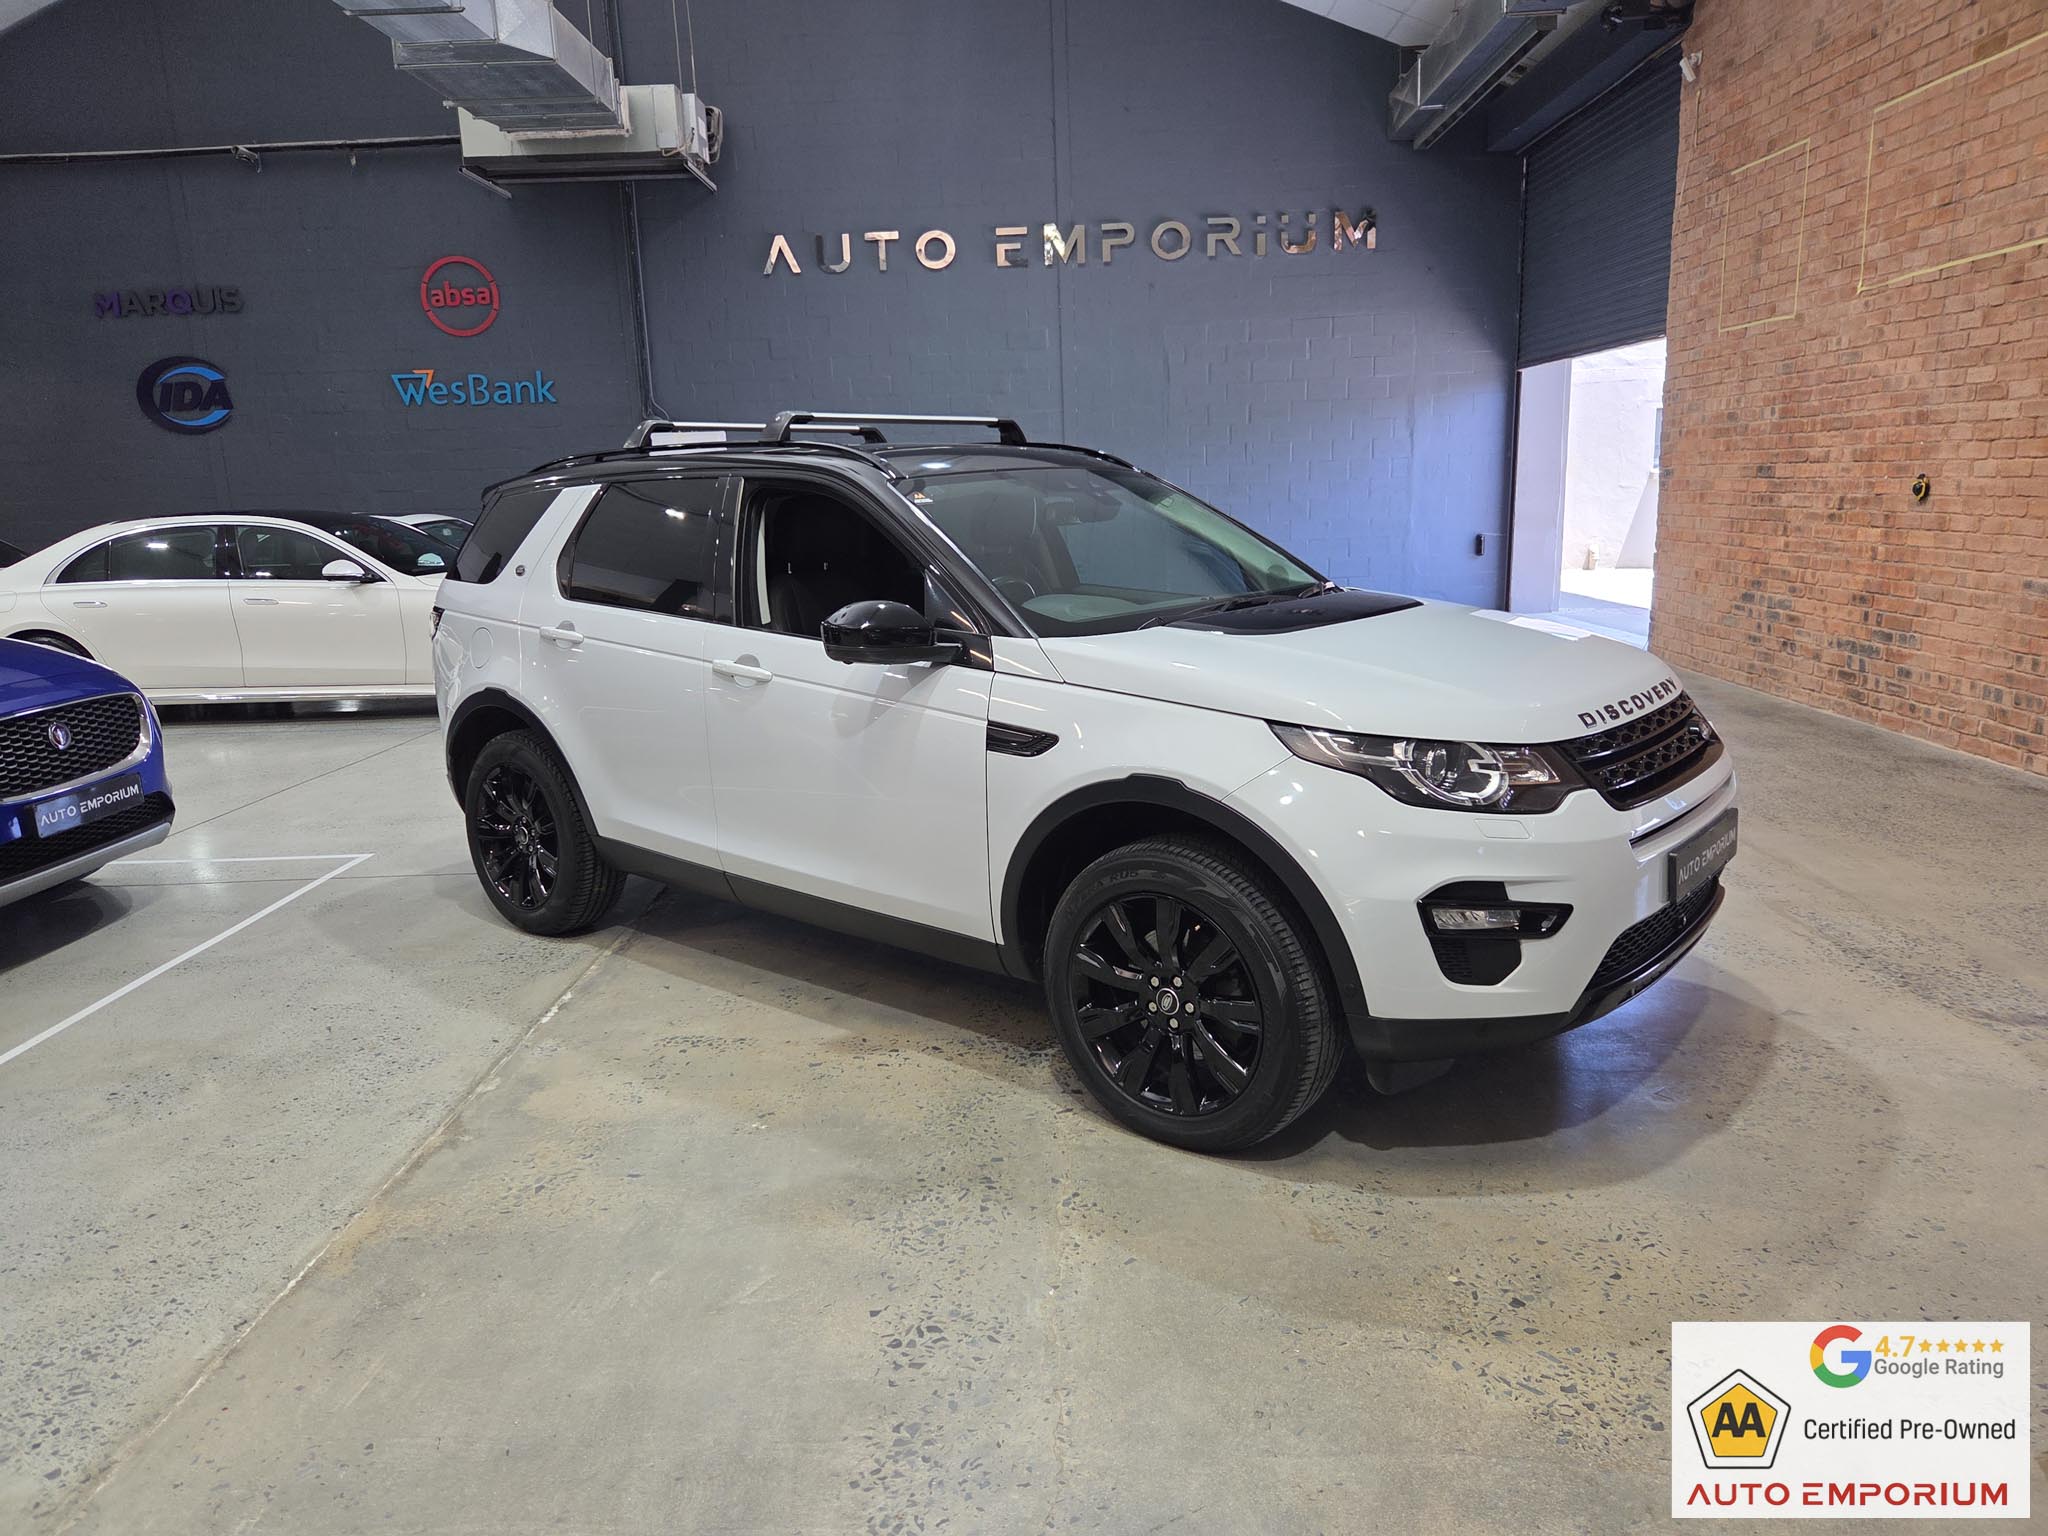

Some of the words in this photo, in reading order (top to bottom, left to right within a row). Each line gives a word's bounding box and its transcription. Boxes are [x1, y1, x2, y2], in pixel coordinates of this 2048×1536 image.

[762, 228, 957, 276] AUTO
[94, 286, 244, 319] MARQUIS
[431, 281, 491, 309] absa
[391, 369, 557, 407] WesBank
[1578, 677, 1677, 729] DISCOVERY
[40, 805, 77, 826] AUTO
[80, 784, 139, 813] EMPORIUM
[1678, 856, 1700, 884] AUTO
[1702, 827, 1736, 868] EMPORIUM
